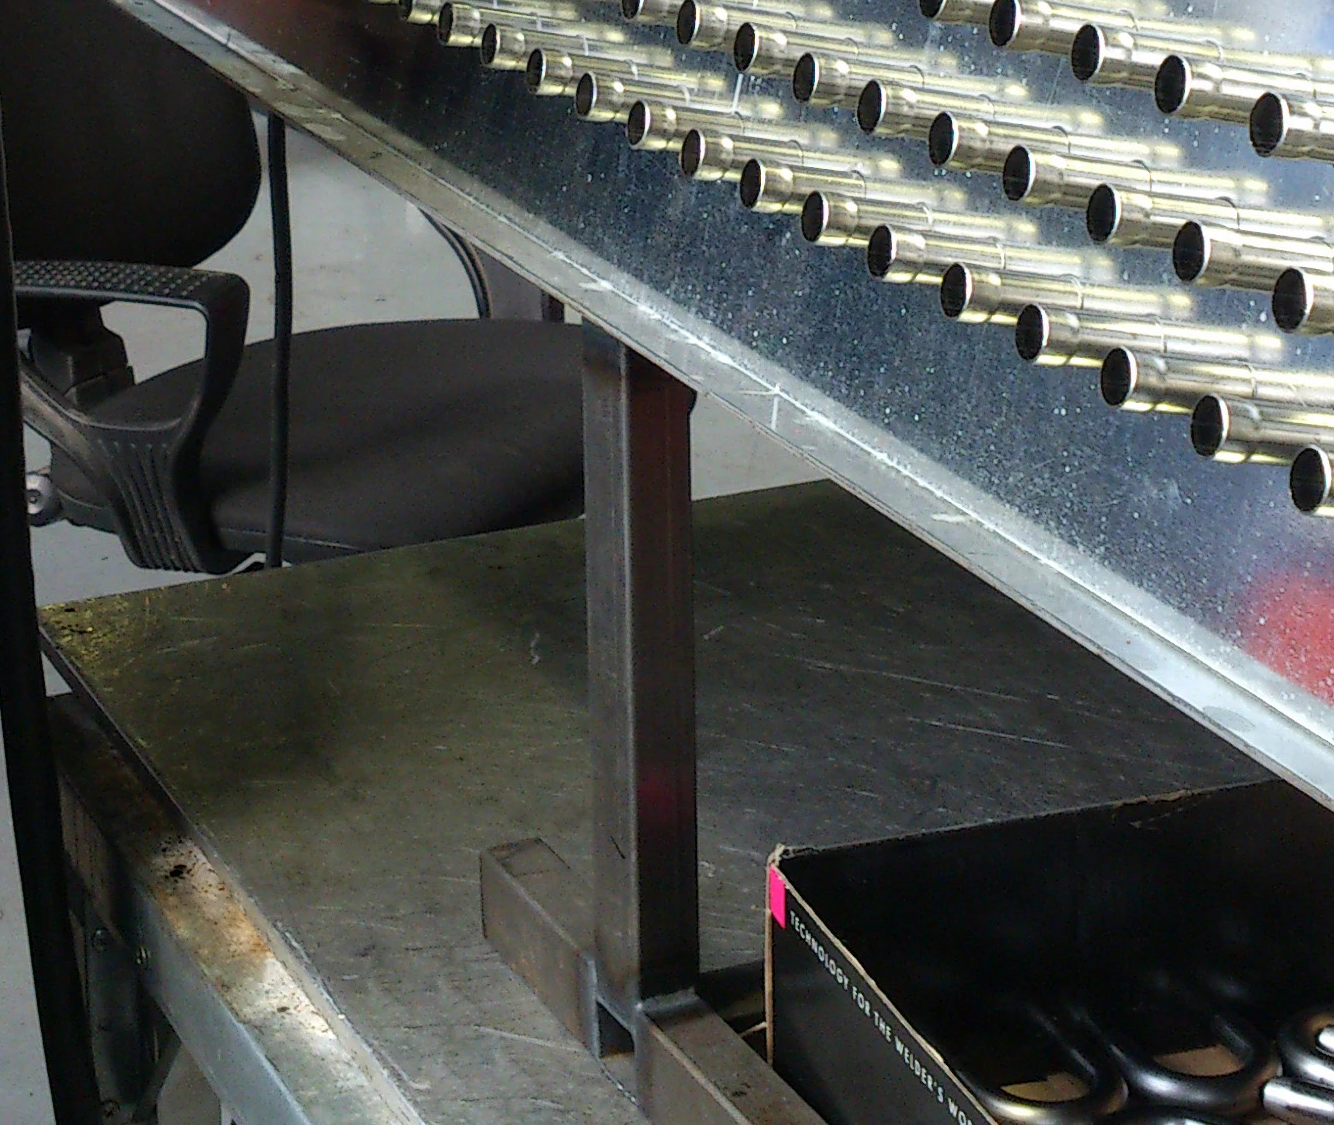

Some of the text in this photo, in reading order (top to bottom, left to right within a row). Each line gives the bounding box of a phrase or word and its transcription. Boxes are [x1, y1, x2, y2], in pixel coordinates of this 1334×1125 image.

[789, 909, 973, 1125] TECHNOLOGY FOR THE WELDER'S WO
